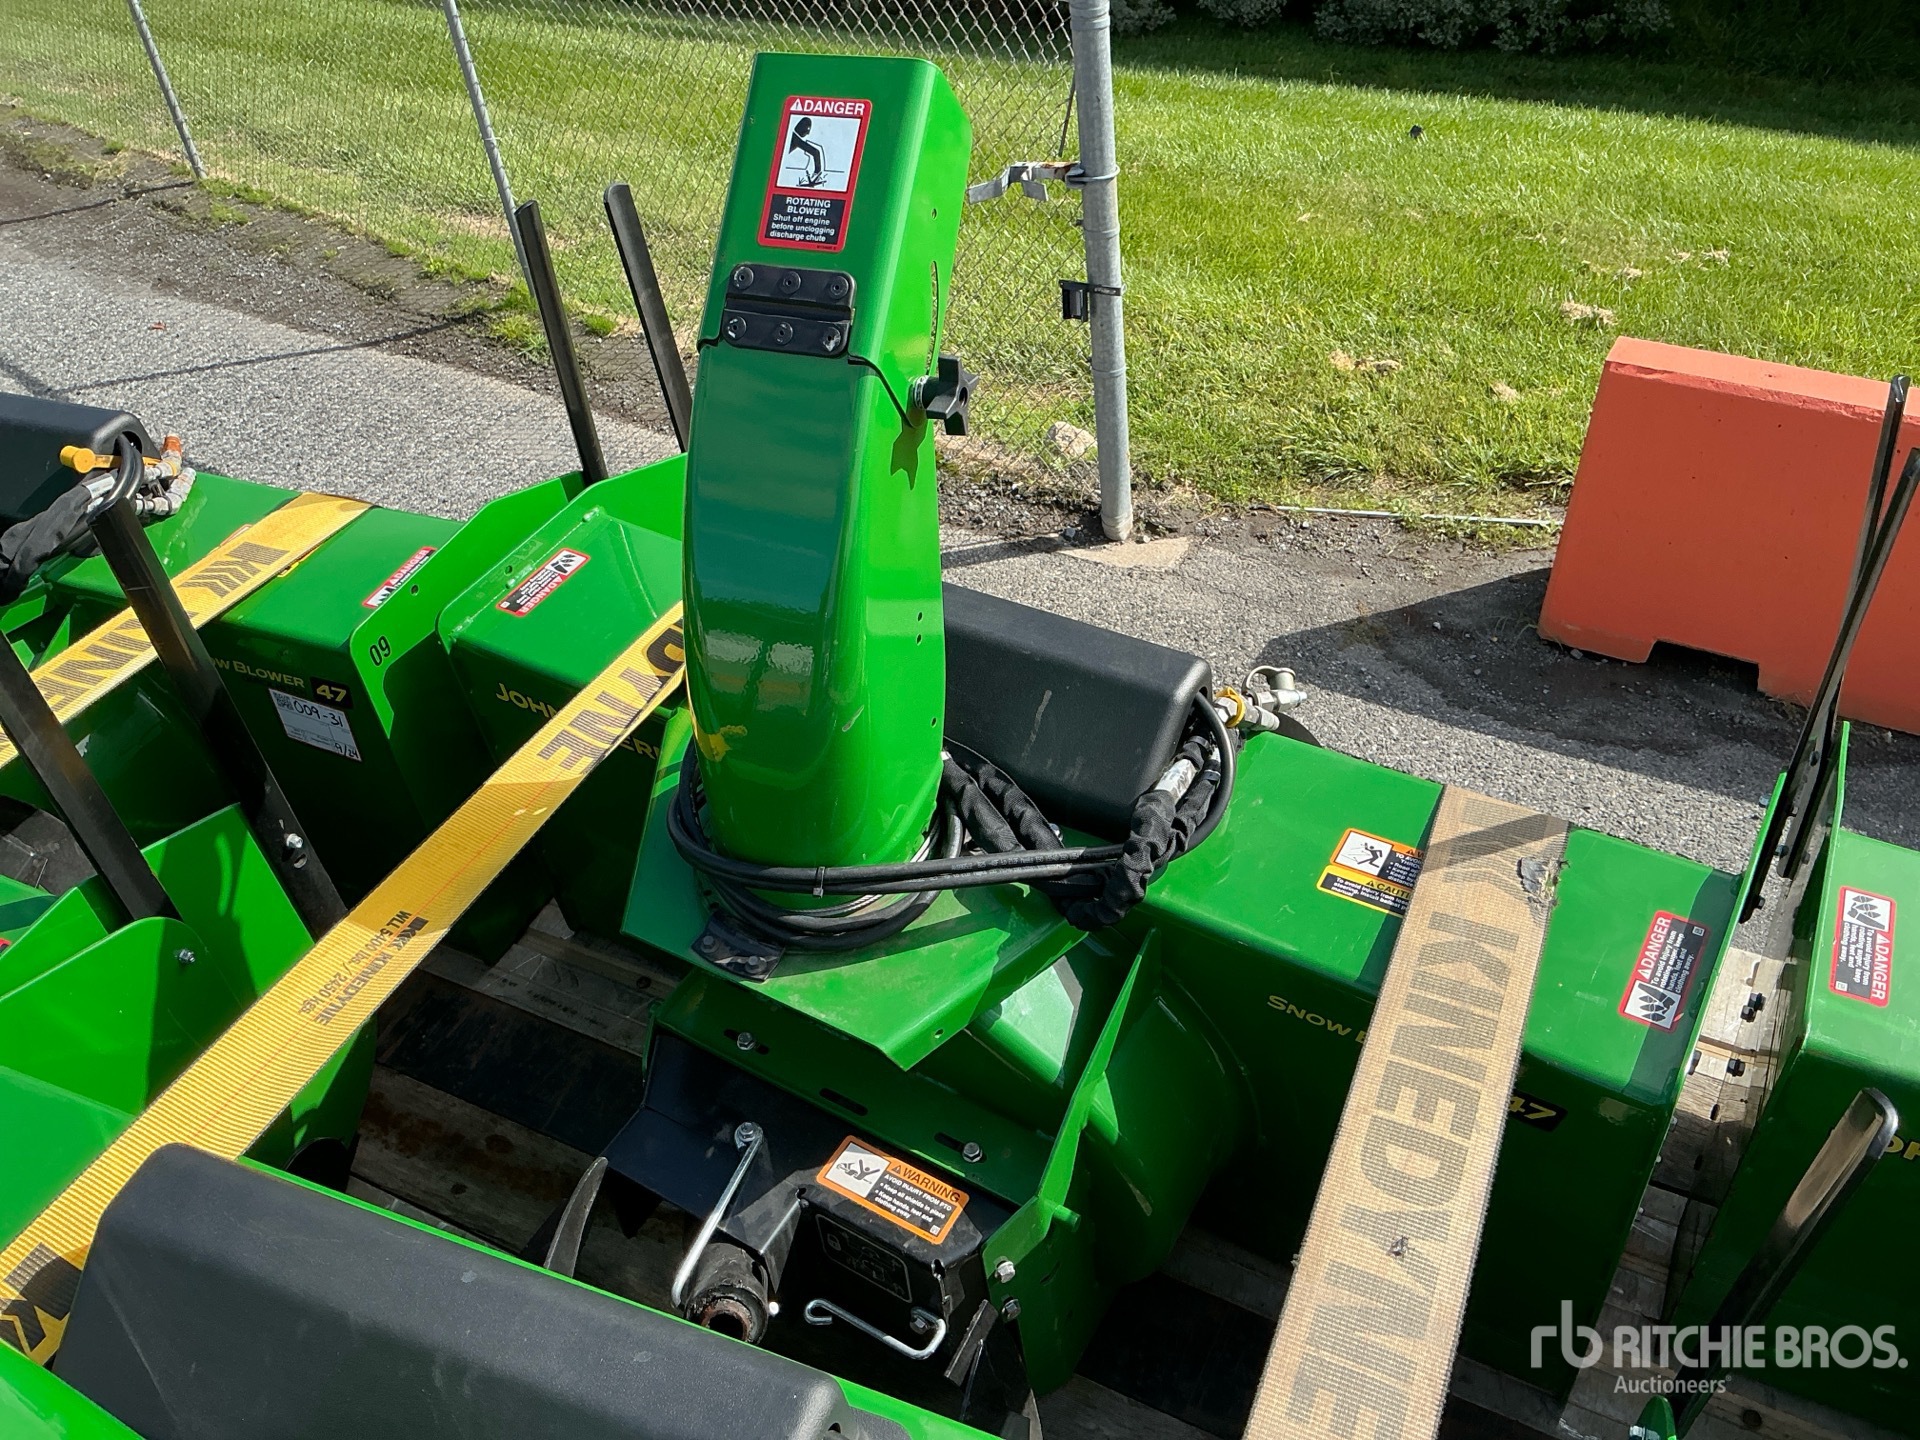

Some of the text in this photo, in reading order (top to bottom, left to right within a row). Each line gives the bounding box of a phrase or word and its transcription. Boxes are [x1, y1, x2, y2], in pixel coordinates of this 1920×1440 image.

[803, 100, 865, 116] DANGER
[786, 196, 831, 208] ROTATING
[786, 206, 827, 216] BLOWER
[771, 222, 835, 236] before unclogging
[773, 214, 790, 222] Shut
[804, 217, 830, 226] engine
[769, 230, 826, 242] discharge chute
[393, 550, 430, 579] DANGER
[520, 581, 558, 612] DANGER
[369, 635, 391, 667] 09
[232, 660, 305, 688] BLOWER
[316, 684, 347, 702] 47
[1376, 882, 1410, 900] CAUTI
[386, 910, 412, 928] WLL
[365, 928, 392, 950] 5400
[1640, 916, 1672, 969] DANGER
[1651, 930, 1677, 985] To avoid injury from
[1660, 964, 1673, 988] rotating
[1674, 933, 1685, 948] keep
[1674, 958, 1683, 971] feet
[1680, 948, 1688, 960] and
[1871, 945, 1890, 1000] DANGER
[314, 951, 394, 1026] KINEDYNE
[318, 972, 347, 996] 2450
[1675, 968, 1690, 993] clothing
[1267, 995, 1352, 1036] SNOW
[904, 1167, 961, 1203] WARNING
[1286, 910, 1520, 1440] KINEDYNE
[879, 1190, 893, 1202] Keep
[911, 1206, 921, 1216] feet
[921, 1212, 933, 1222] and
[884, 1174, 952, 1211] AVOID INJURY FROM PTO
[884, 1184, 898, 1195] Keep
[904, 1194, 924, 1209] shields
[930, 1208, 946, 1220] place
[875, 1196, 911, 1220] clothing away
